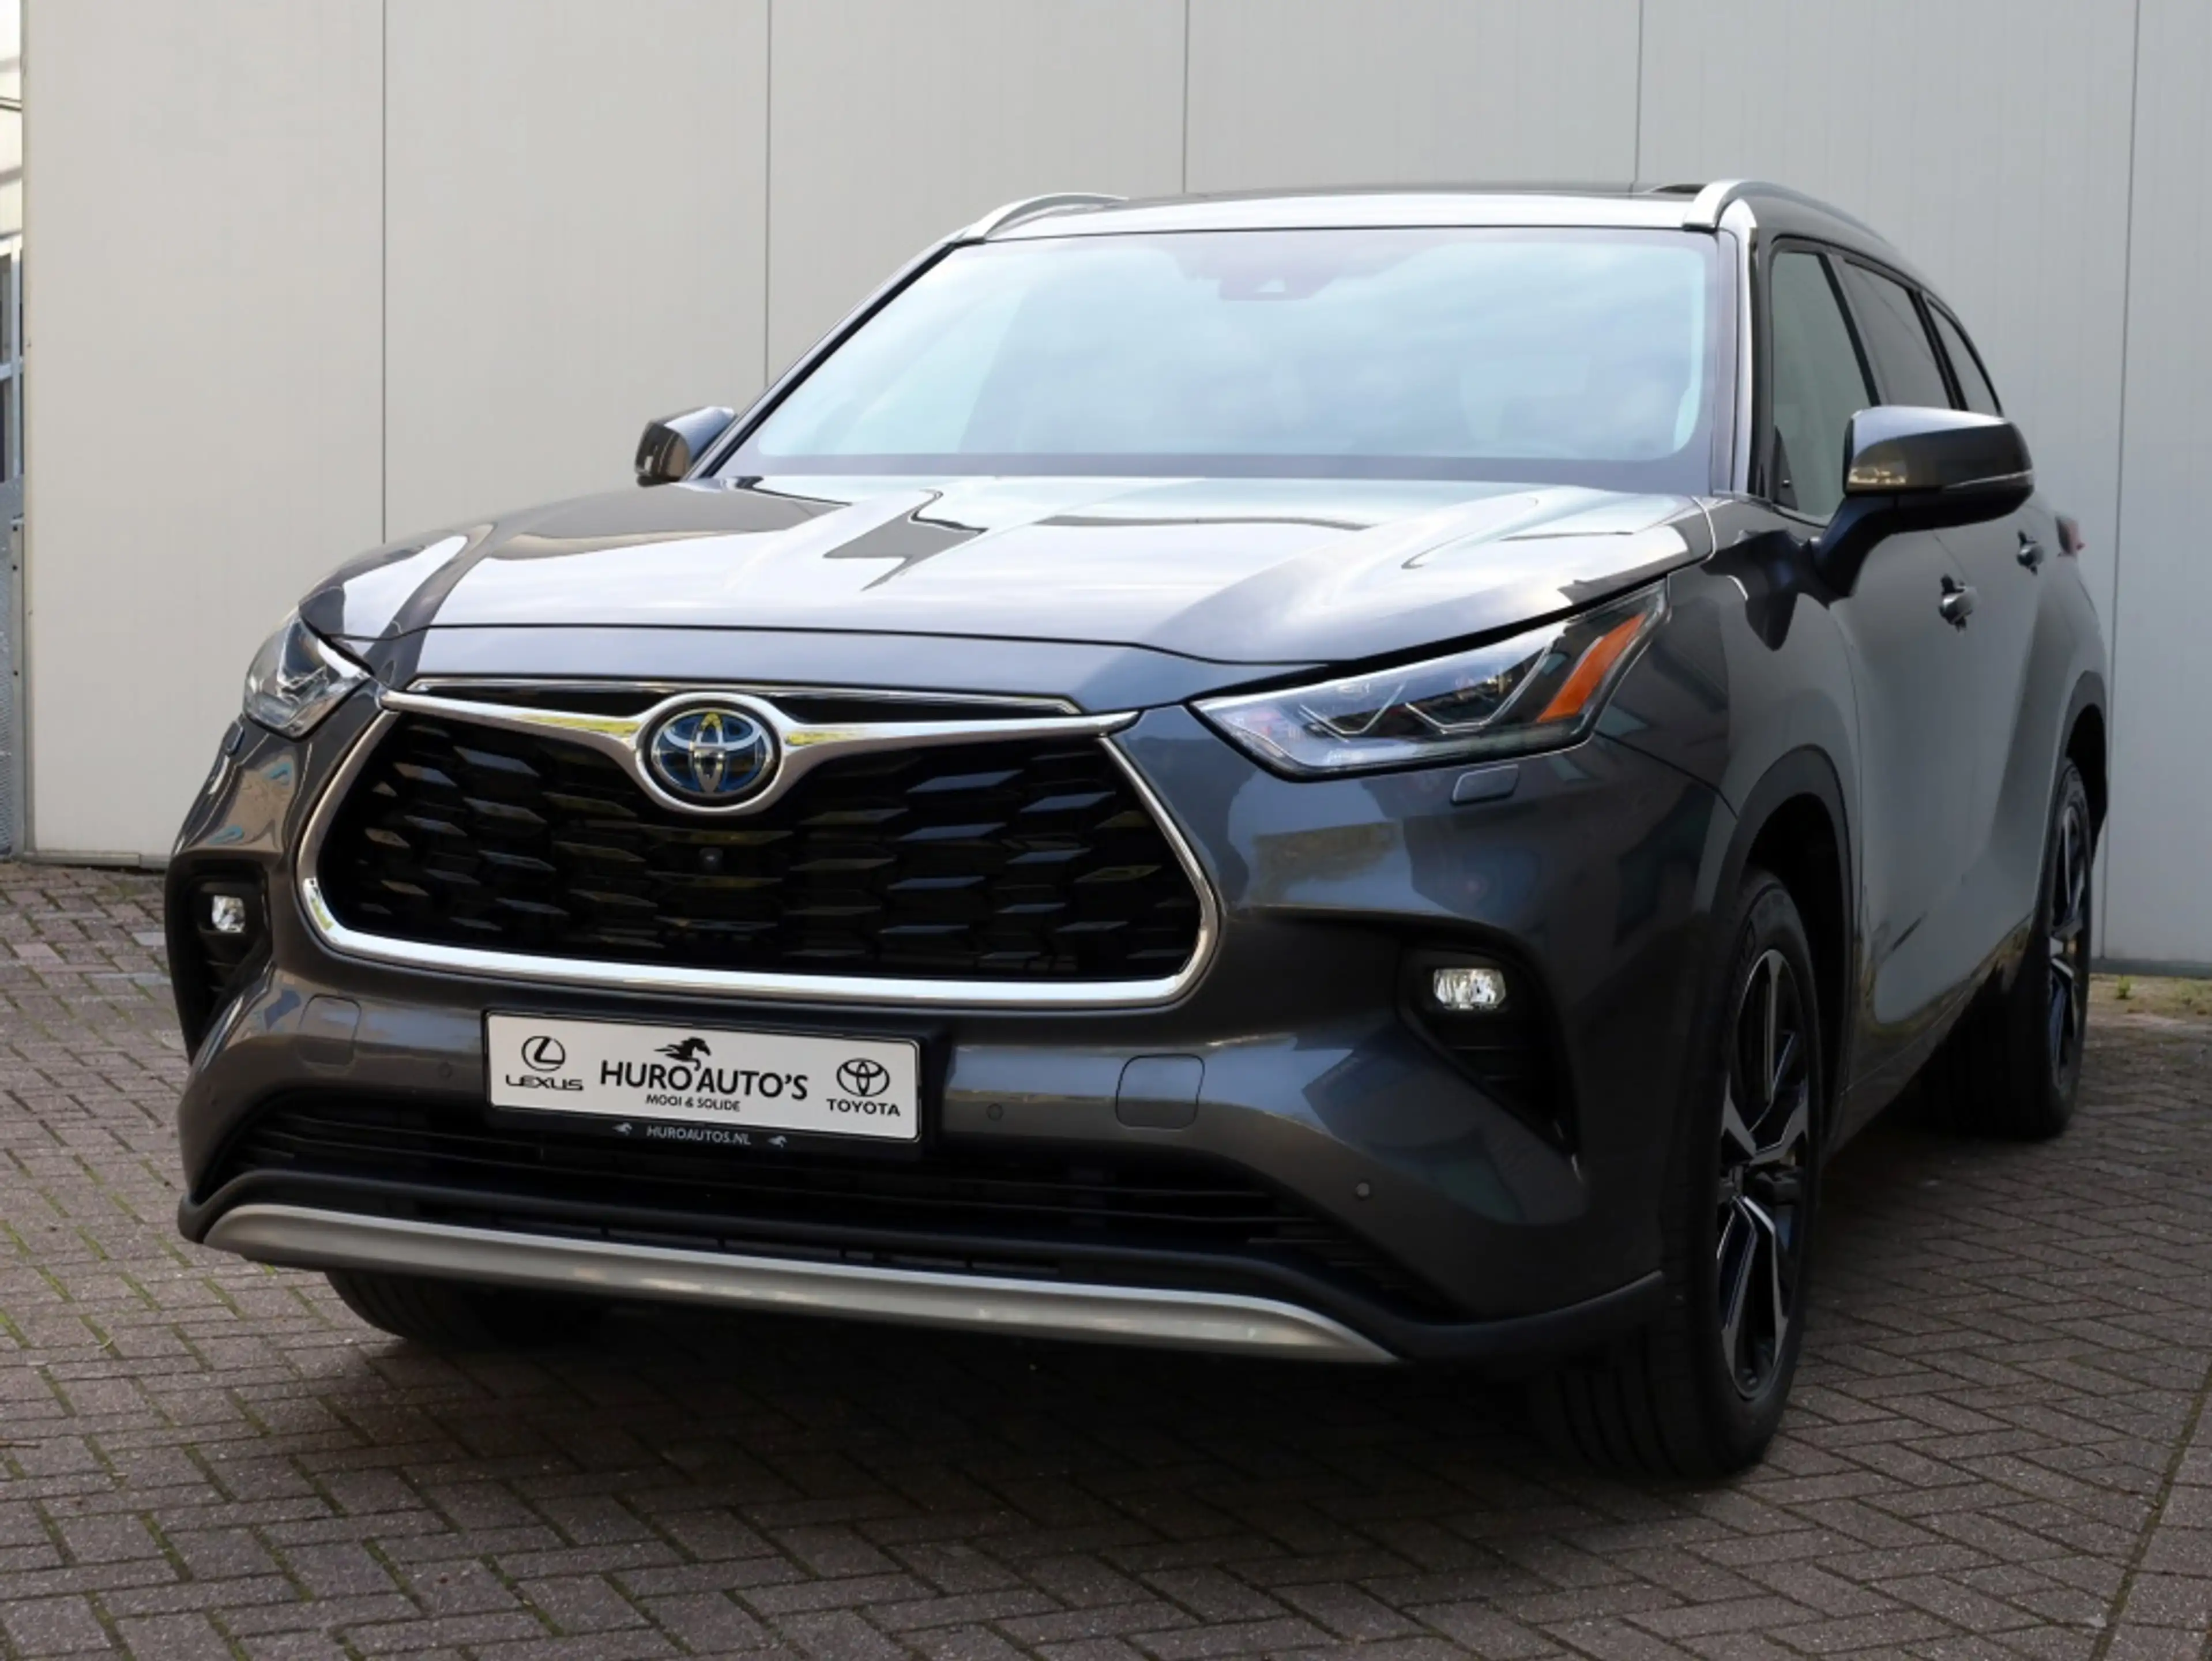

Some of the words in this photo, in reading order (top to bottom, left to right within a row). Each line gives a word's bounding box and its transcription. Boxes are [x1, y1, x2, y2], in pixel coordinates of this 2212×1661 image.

[506, 1074, 584, 1091] LEXUS
[645, 1094, 682, 1106] MOOI
[685, 1097, 694, 1107] &
[697, 1098, 741, 1112] SOLIDE
[826, 1098, 901, 1117] TOYOTA
[646, 1126, 751, 1145] HUROAUTOS.NL
